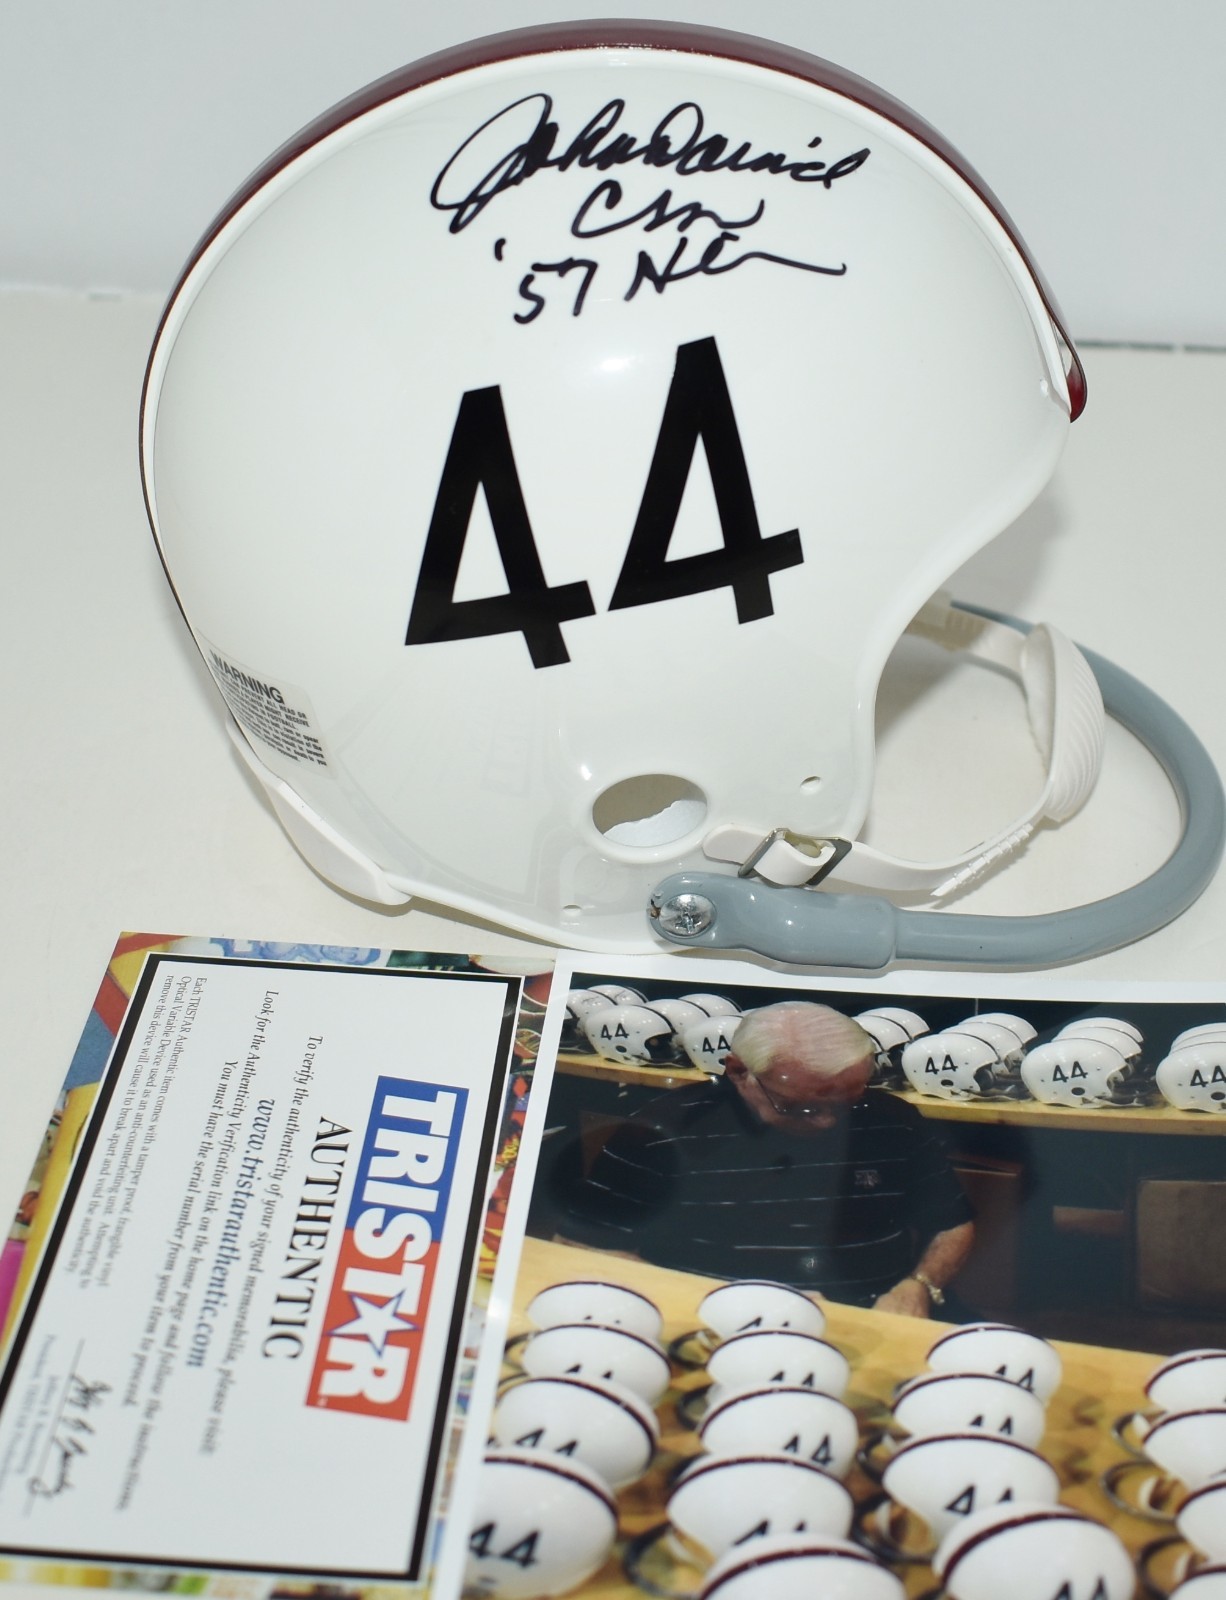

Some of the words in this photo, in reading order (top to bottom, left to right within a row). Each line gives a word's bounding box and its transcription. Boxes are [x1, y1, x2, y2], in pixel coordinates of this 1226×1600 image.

[404, 335, 805, 670] 44
[209, 649, 285, 705] WARNING
[158, 975, 174, 1004] remove
[173, 975, 192, 1004] Optical
[191, 977, 208, 995] Each
[152, 1004, 166, 1019] this
[179, 996, 201, 1033] TRISTAR
[260, 990, 279, 1015] Look
[143, 1020, 161, 1046] device
[162, 1005, 183, 1037] Variable
[254, 1015, 272, 1032] for
[601, 1022, 630, 1041] 44
[137, 1047, 150, 1063] will
[152, 1039, 172, 1066] Device
[166, 1034, 188, 1074] Authentic
[250, 1034, 266, 1051] the
[306, 1036, 323, 1050] To
[129, 1064, 143, 1088] cause
[145, 1068, 159, 1087] used
[220, 1061, 238, 1080] You
[293, 1052, 315, 1085] verify
[925, 1053, 960, 1076] 44
[1052, 1060, 1089, 1083] 44
[141, 1088, 152, 1098] as
[159, 1075, 176, 1094] item
[211, 1082, 228, 1110] must
[226, 1051, 261, 1119] Authenticity
[292, 1087, 309, 1106] the
[123, 1097, 135, 1106] to
[137, 1099, 148, 1111] an
[150, 1095, 165, 1123] comes
[114, 1107, 133, 1131] break
[203, 1111, 224, 1138] have
[143, 1124, 157, 1144] with
[268, 1107, 300, 1181] authenticity
[108, 1112, 144, 1193] anti-counterfeiting
[197, 1140, 214, 1159] the
[210, 1122, 242, 1187] Verification
[129, 1153, 149, 1186] tamper
[186, 1160, 205, 1194] serial
[202, 1190, 223, 1213] link
[263, 1183, 284, 1198] of
[173, 1195, 195, 1240] number
[197, 1216, 210, 1232] on
[260, 1198, 277, 1229] your
[186, 1098, 275, 1367] www.tristarauthentic.com
[191, 1234, 209, 1254] the
[263, 1116, 352, 1359] AUTHENTIC
[163, 1240, 185, 1271] from
[248, 1231, 271, 1273] signed
[181, 1256, 204, 1289] home
